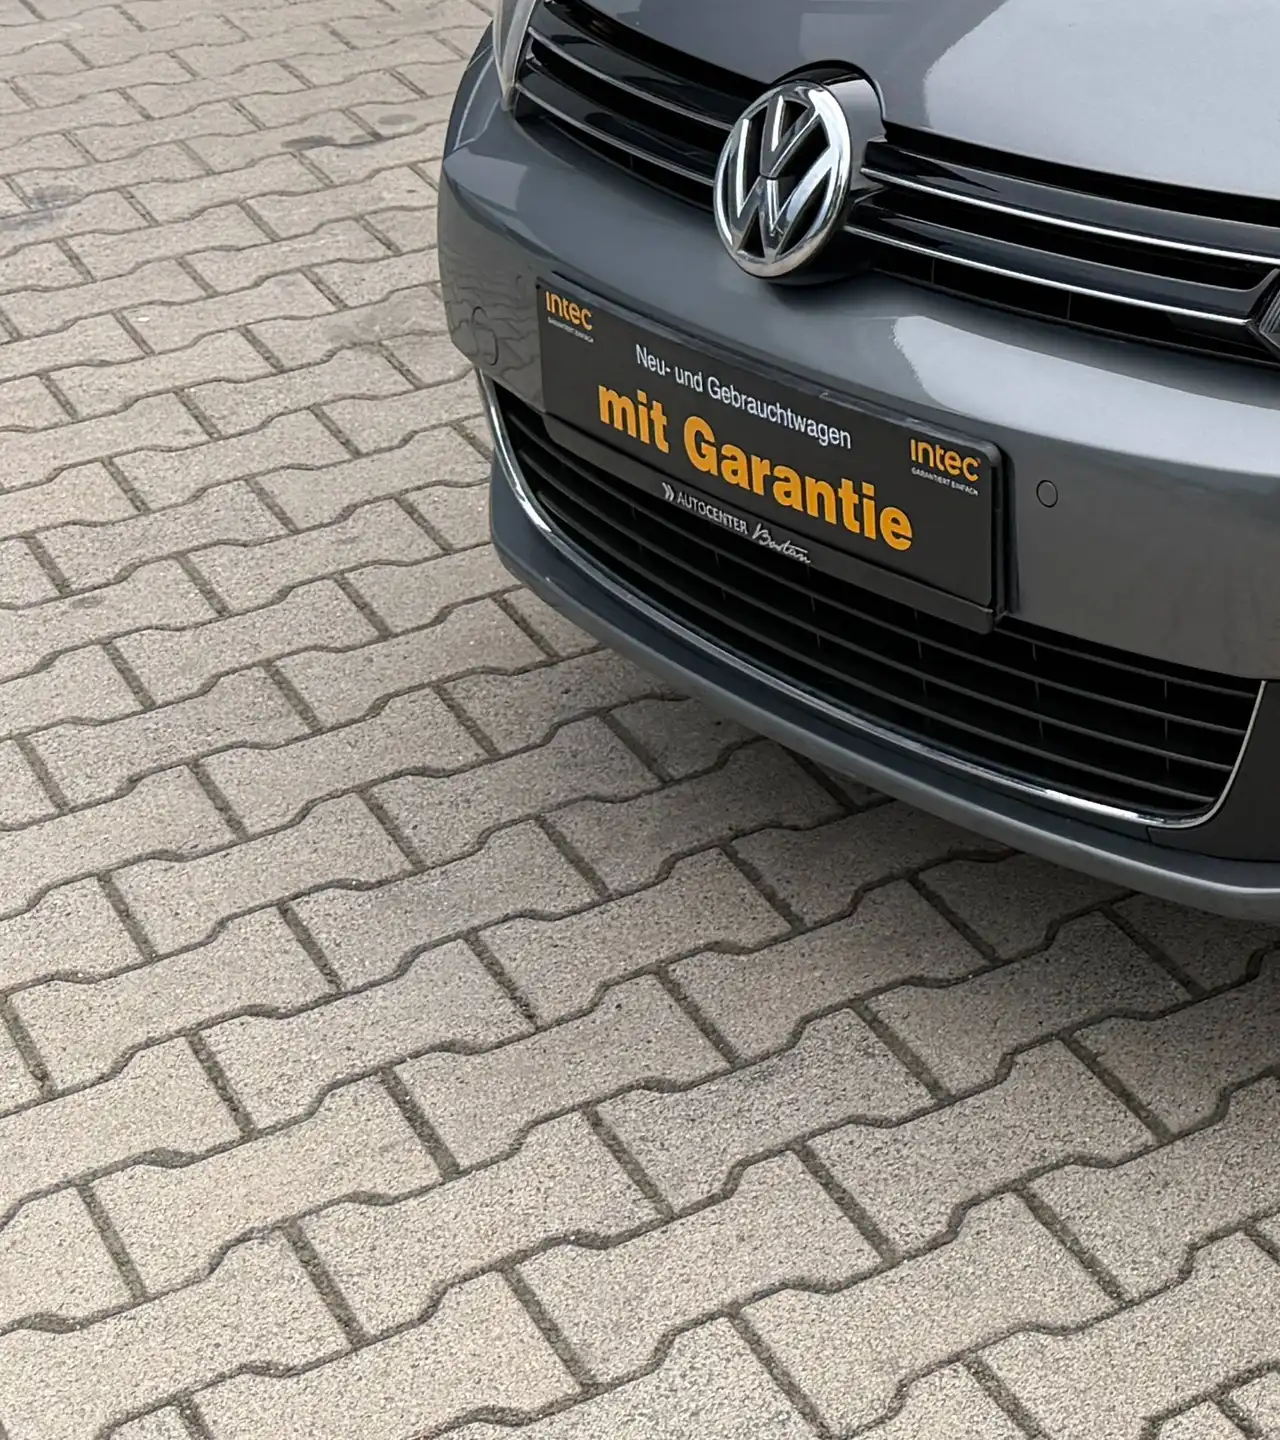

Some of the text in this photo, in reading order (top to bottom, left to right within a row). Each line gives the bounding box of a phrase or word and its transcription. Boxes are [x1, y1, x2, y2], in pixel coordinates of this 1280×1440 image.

[546, 291, 592, 330] intec
[636, 344, 852, 450] Neu- und Gebrauchtwagen
[598, 384, 913, 552] mit Garantie
[910, 439, 979, 482] intec
[676, 491, 748, 535] AUTOCENTER
